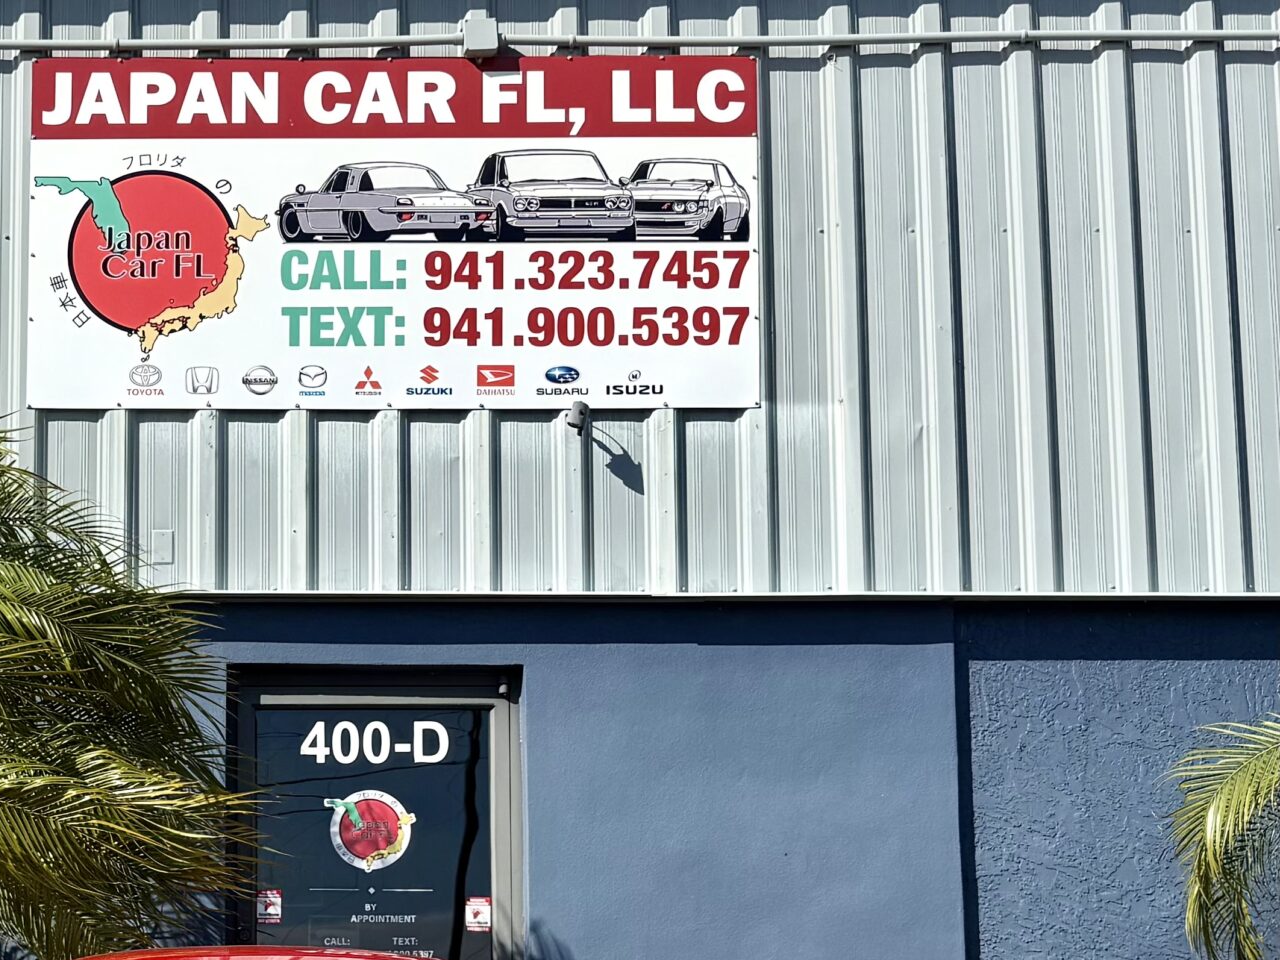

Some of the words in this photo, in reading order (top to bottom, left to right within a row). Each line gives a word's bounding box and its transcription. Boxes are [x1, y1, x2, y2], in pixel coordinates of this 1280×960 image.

[41, 71, 279, 126] JAPAN
[303, 70, 456, 125] CAR
[482, 70, 586, 136] FL,
[611, 69, 746, 124] LLC
[122, 153, 187, 170] フロリダ
[215, 179, 233, 194] の
[97, 226, 193, 258] Japan
[100, 253, 166, 280] Car
[173, 253, 216, 280] FL
[280, 249, 407, 291] CALL:
[423, 249, 751, 291] 941.323.7457
[280, 306, 407, 347] TEXT:
[423, 305, 751, 348] 941.900.5397
[244, 377, 275, 385] NISSAN
[126, 388, 165, 397] TOYOTA
[406, 387, 453, 396] SUZUKI
[476, 388, 516, 396] DAIHATSU
[536, 387, 589, 396] SUBARU
[605, 385, 664, 395] ISUZU
[299, 720, 450, 764] 400-D
[364, 903, 377, 912] BY
[350, 914, 417, 923] APPOINTMENT
[324, 937, 351, 946] CALL:
[392, 937, 418, 946] TEXT:
